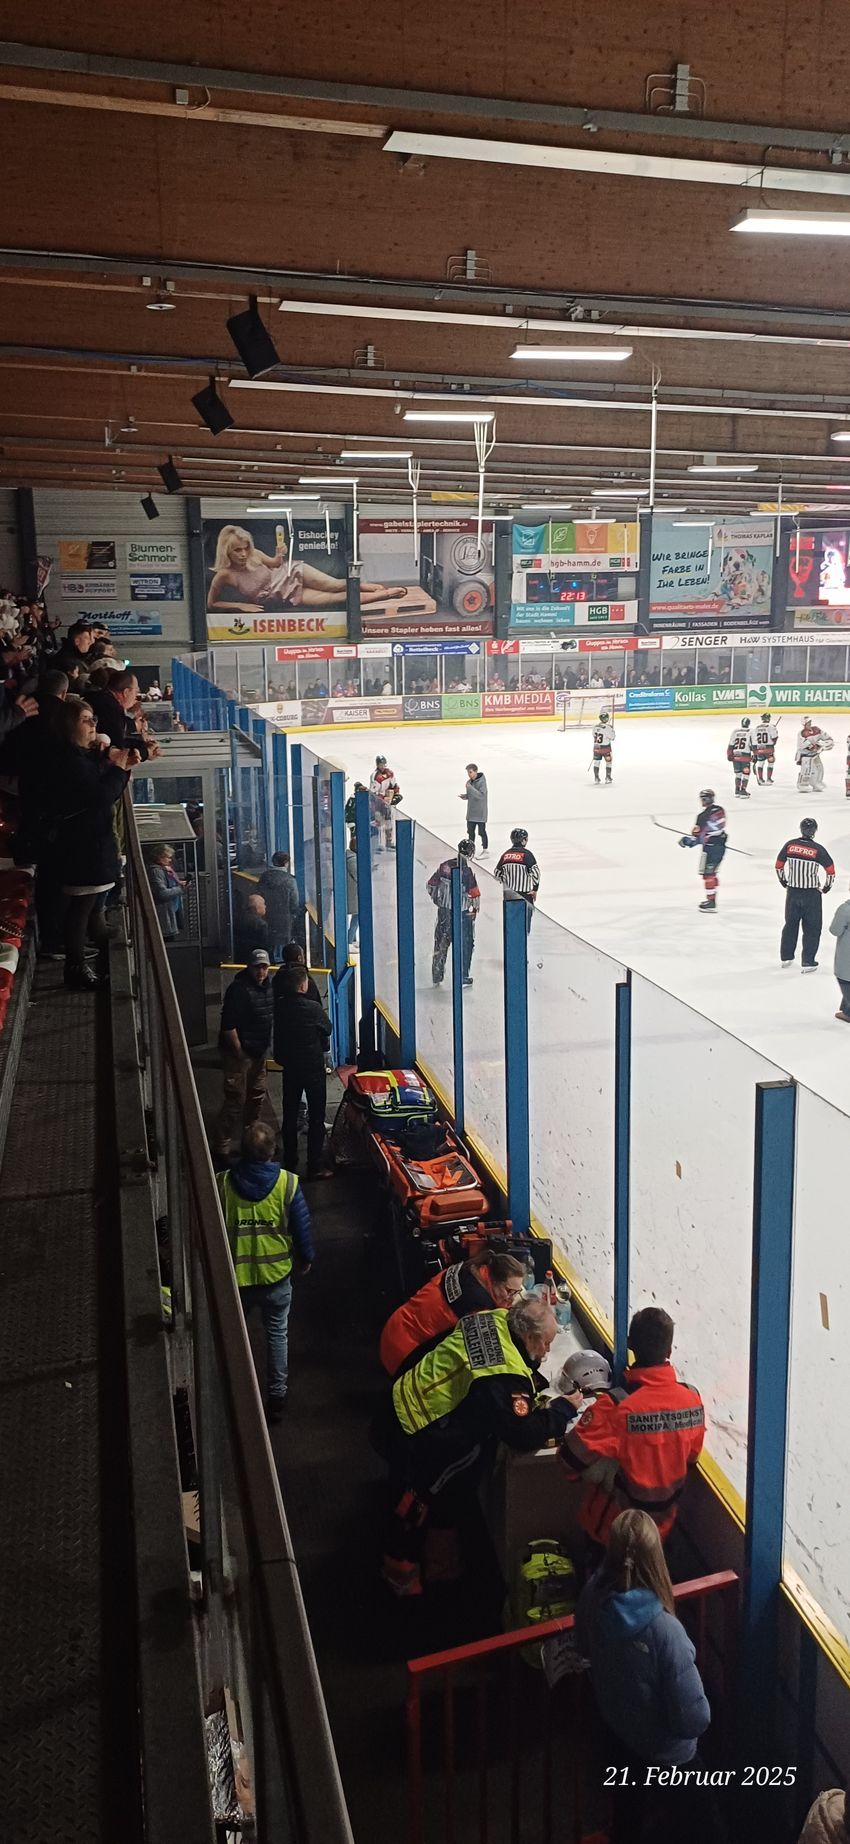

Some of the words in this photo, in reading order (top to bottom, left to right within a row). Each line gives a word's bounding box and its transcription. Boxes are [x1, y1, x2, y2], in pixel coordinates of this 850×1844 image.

[369, 520, 468, 528] www.gabelstplertechnik.de
[298, 530, 339, 541] Eishocey
[130, 543, 176, 553] Blumen-
[298, 541, 339, 551] genießn!
[128, 553, 177, 562] Schmohr
[652, 552, 672, 561] WIR
[674, 549, 714, 560] BRINGE
[550, 559, 602, 568] hgb-hamm.de
[661, 565, 692, 575] FARBE
[677, 575, 711, 587] LEBEN!
[253, 617, 326, 633] ISENBECK
[390, 626, 419, 635] Stapler
[420, 625, 444, 633] heben
[445, 624, 460, 632] fast
[461, 624, 482, 632] alles!
[681, 636, 728, 647] SENGER
[762, 635, 814, 644] SYSTEMHAUS
[484, 694, 512, 706] KMB
[514, 693, 552, 705] MEDIA
[674, 691, 706, 703] Kollas
[775, 690, 801, 702] WIR
[804, 689, 850, 702] HALTEN
[420, 700, 441, 710] BNS
[459, 699, 479, 708] BNS
[344, 709, 368, 717] KAISER
[734, 737, 747, 750] 26
[756, 732, 768, 744] 20
[788, 846, 816, 857] GEFRO
[234, 1218, 275, 1227] ORDNER
[482, 1331, 497, 1363] MEDICAL
[630, 1421, 669, 1432] MOKIPA
